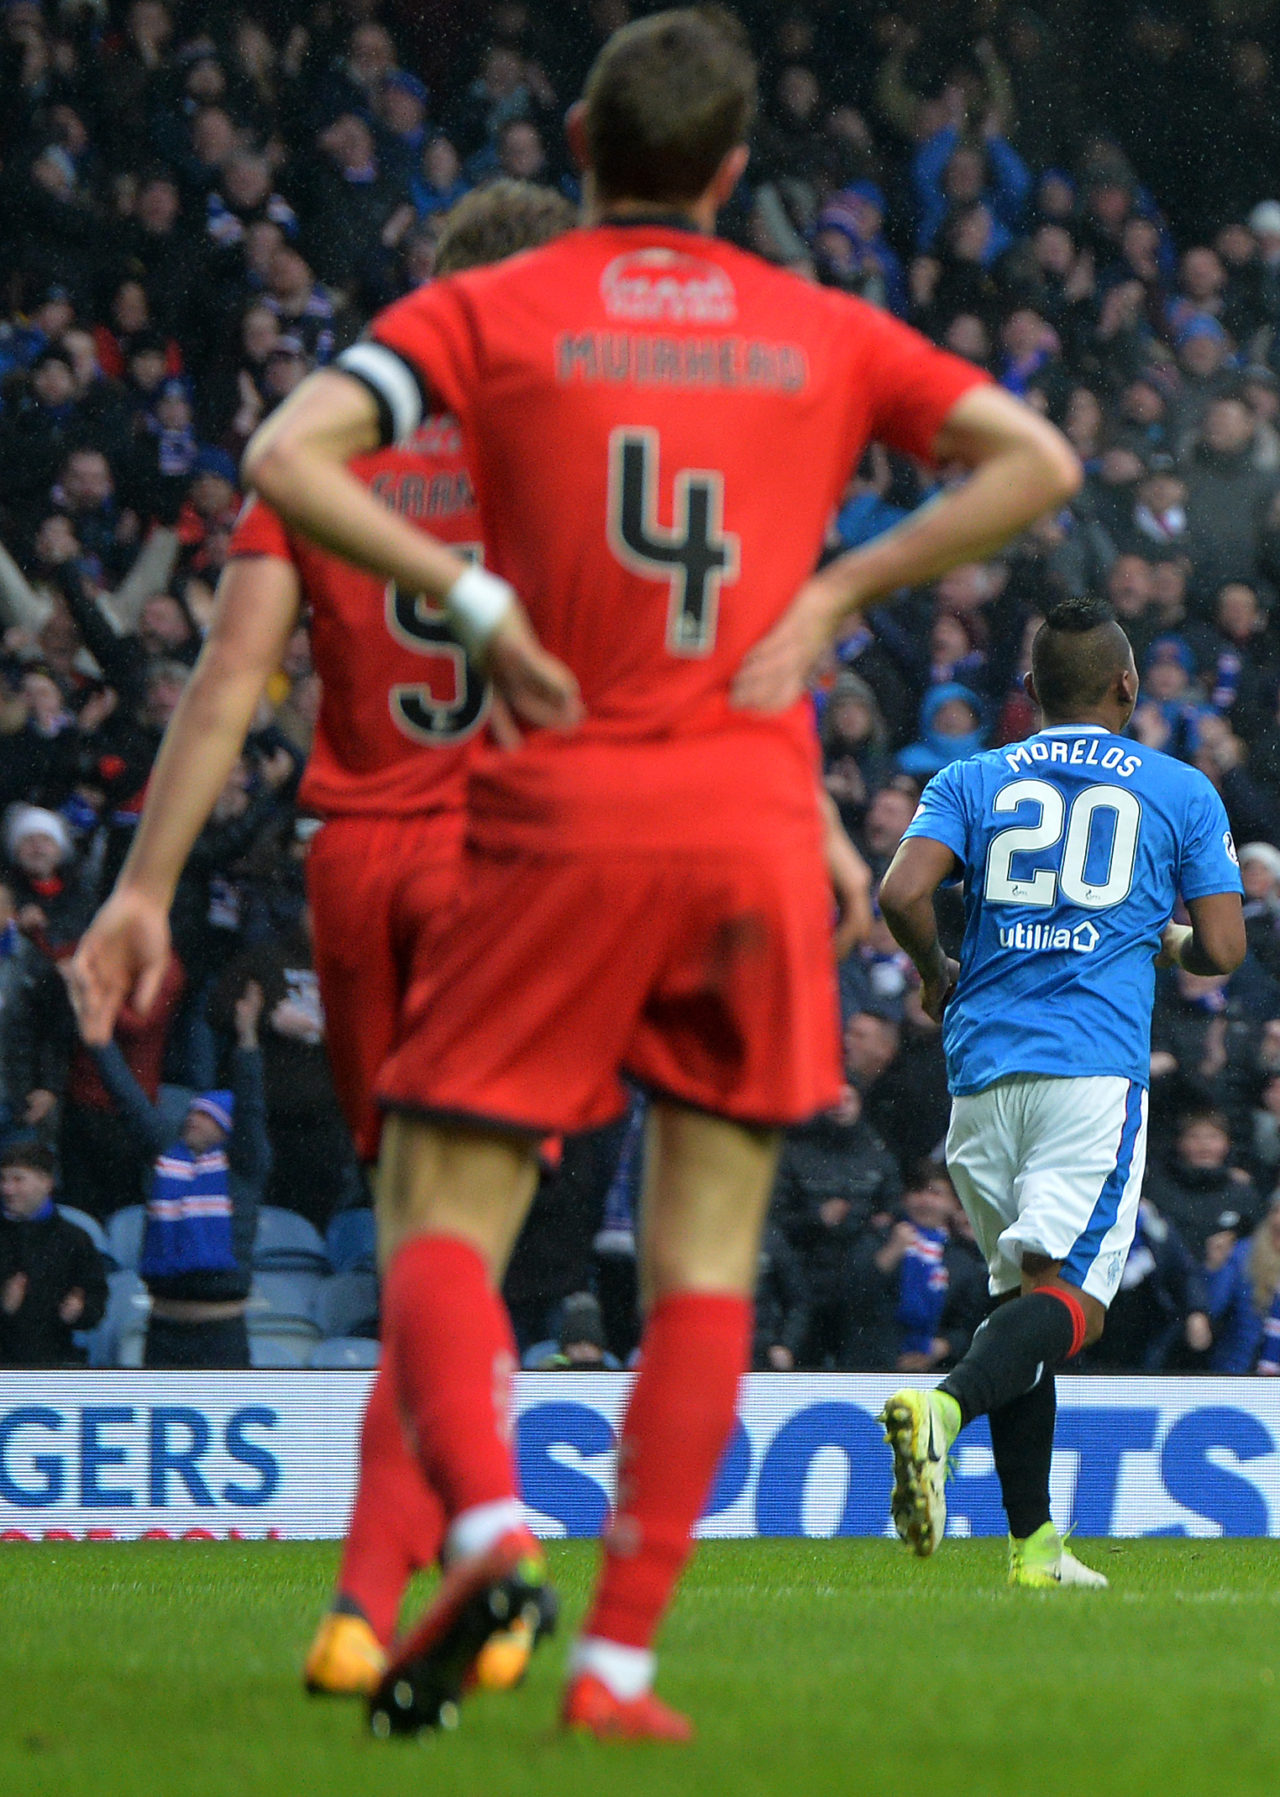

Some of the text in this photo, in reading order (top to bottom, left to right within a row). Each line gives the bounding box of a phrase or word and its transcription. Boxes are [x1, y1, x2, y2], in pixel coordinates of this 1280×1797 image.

[557, 331, 807, 392] MUIRHEAD
[608, 427, 740, 658] 4
[1005, 739, 1143, 778] MORELOS
[985, 778, 1142, 908] 20
[0, 1405, 281, 1508] GERS
[514, 1400, 1276, 1538] SOTS
